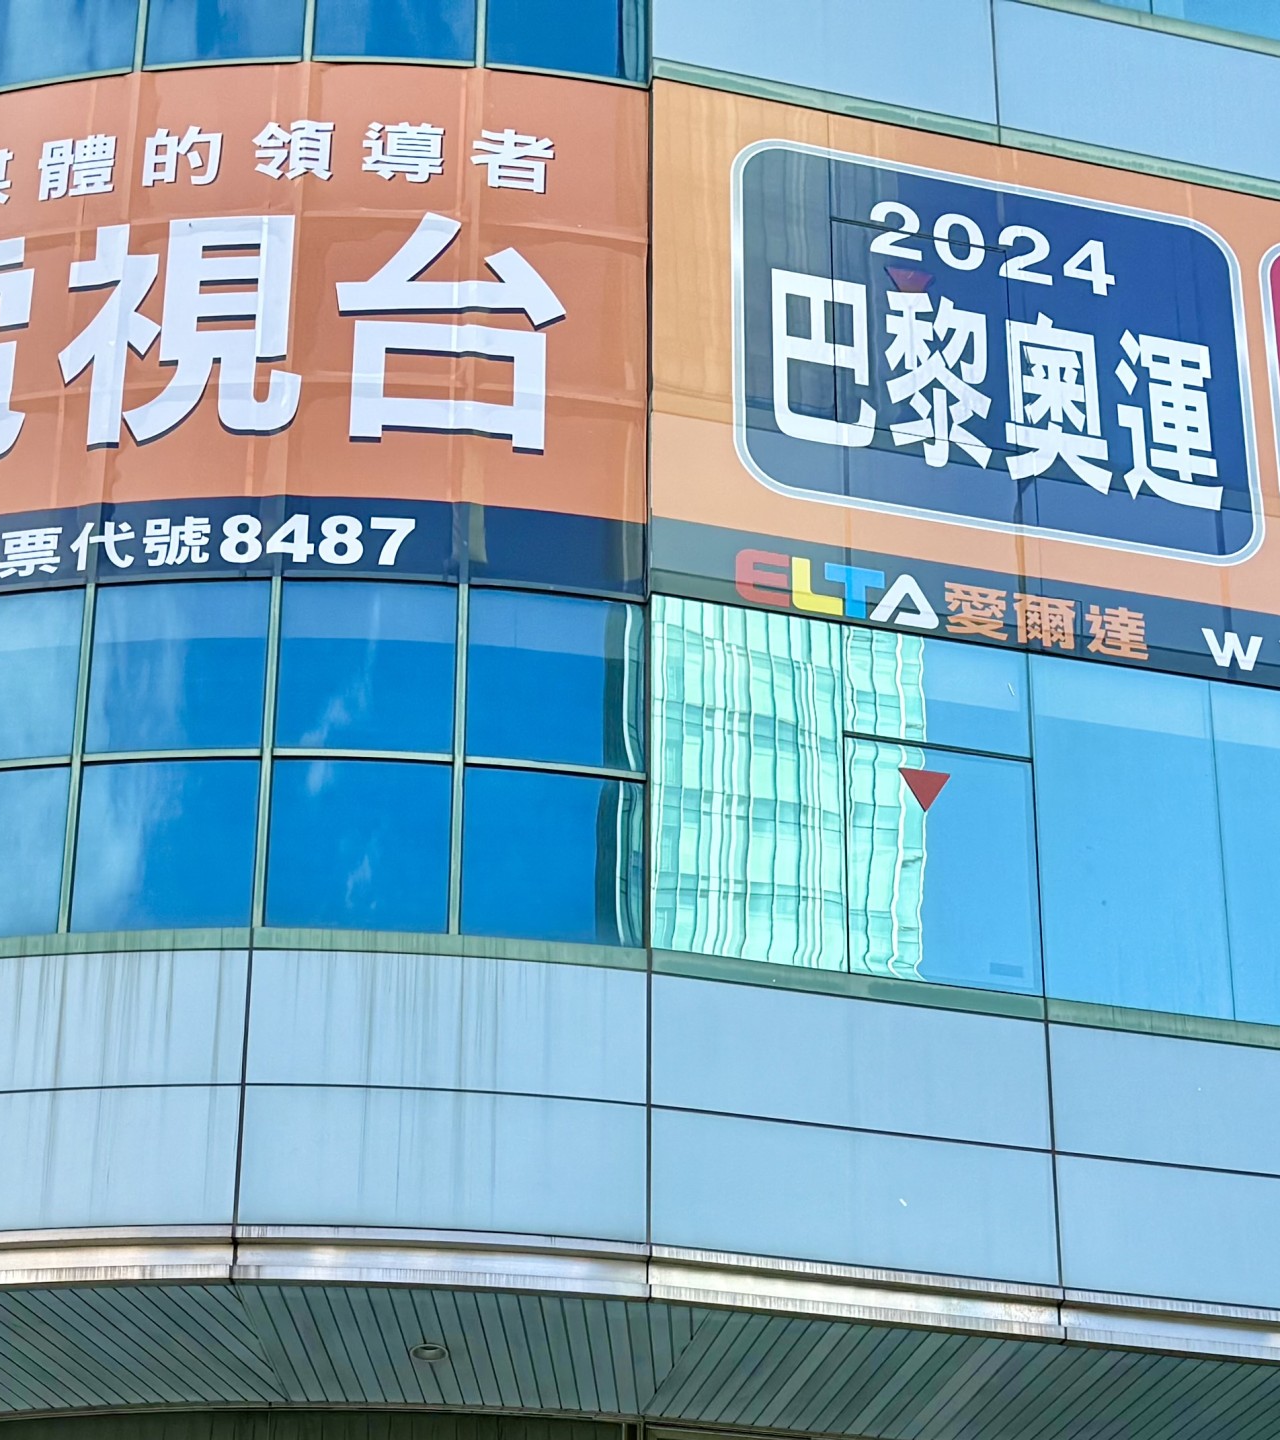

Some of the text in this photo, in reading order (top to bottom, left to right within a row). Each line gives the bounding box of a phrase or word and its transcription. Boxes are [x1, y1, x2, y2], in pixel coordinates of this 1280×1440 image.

[869, 200, 1116, 297] 2024
[770, 267, 1224, 512] 巴黎奧運
